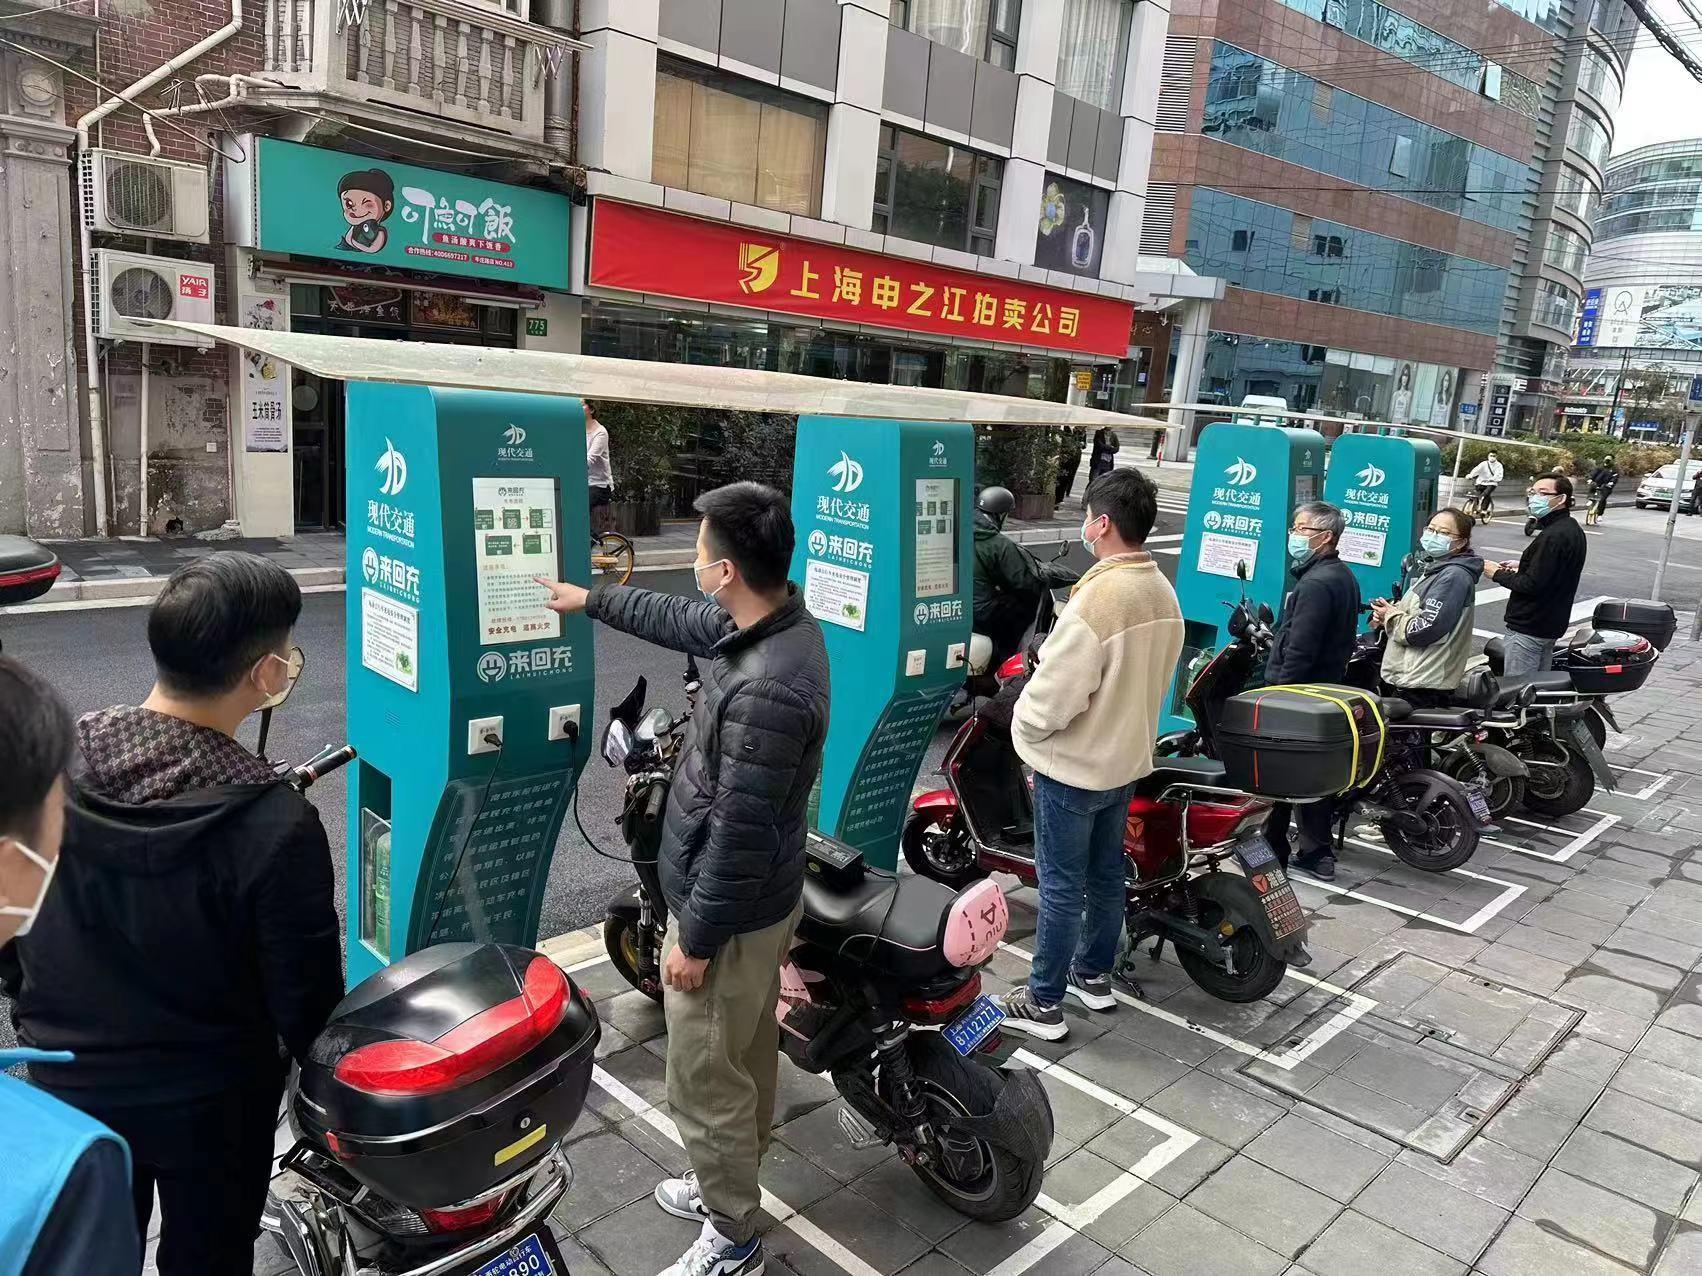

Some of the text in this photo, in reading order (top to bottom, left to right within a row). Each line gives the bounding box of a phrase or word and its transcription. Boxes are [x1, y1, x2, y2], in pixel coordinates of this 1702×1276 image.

[181, 276, 208, 287] YAIR
[790, 260, 1080, 337] 上海申之江拍卖公司
[528, 320, 545, 330] 775
[498, 447, 533, 458] 现代交通
[1213, 487, 1261, 506] 现代交通
[1345, 488, 1389, 505] 现代交通
[816, 495, 870, 522] 现代交通
[367, 499, 415, 538] 现代交通
[1221, 514, 1263, 533] 来回充
[1353, 512, 1391, 528] 来回充
[828, 535, 874, 564] 来回充
[379, 555, 420, 596] 来回充
[929, 600, 963, 619] 来回充
[509, 645, 573, 673] 来回充
[955, 1005, 996, 1046] 8712777
